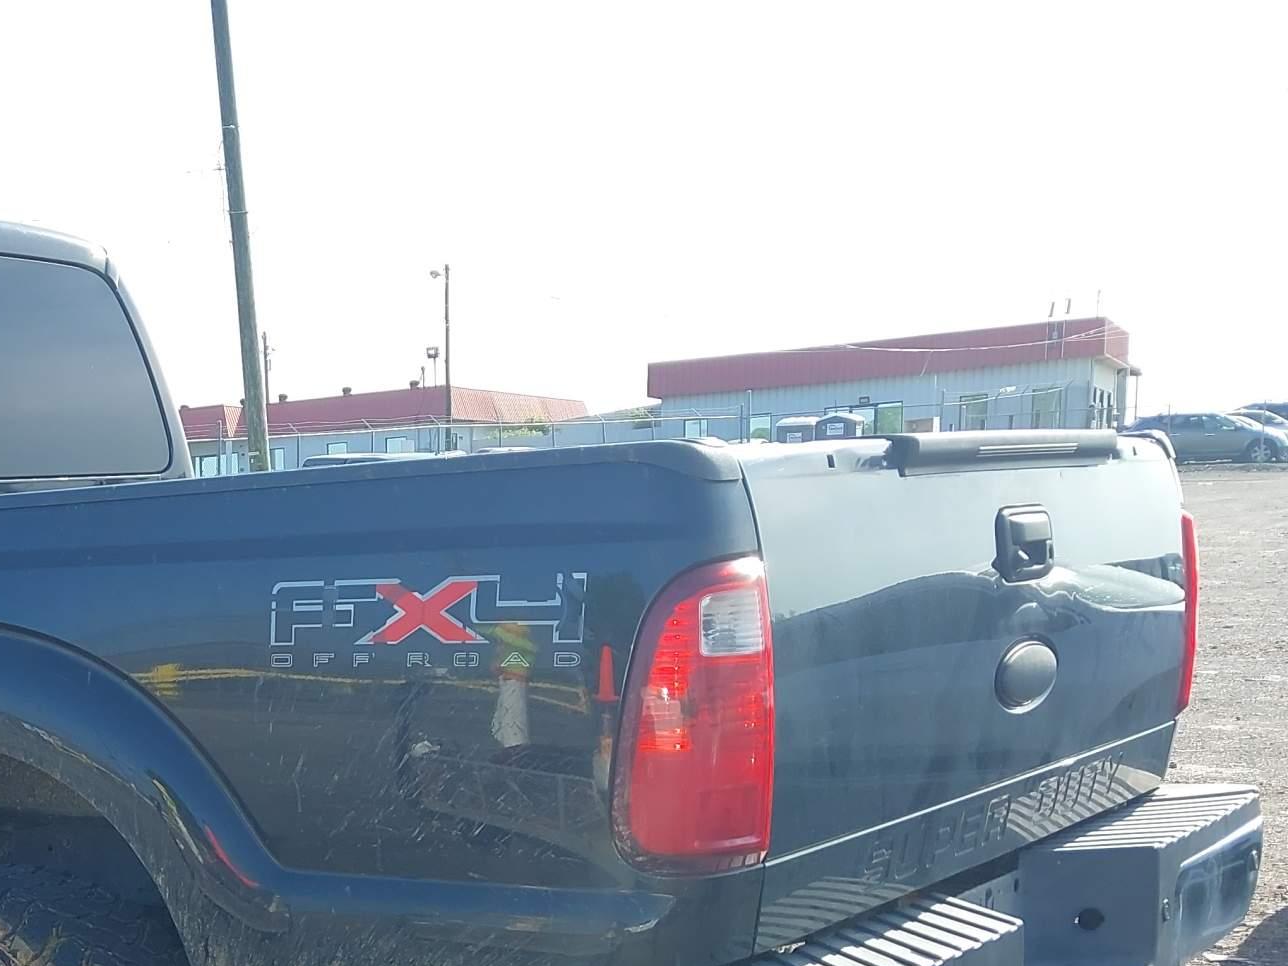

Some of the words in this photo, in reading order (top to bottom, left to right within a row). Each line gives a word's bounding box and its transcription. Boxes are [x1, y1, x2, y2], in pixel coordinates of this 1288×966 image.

[269, 572, 587, 647] FX4
[270, 652, 375, 668] OFF
[406, 651, 582, 668] ROAD
